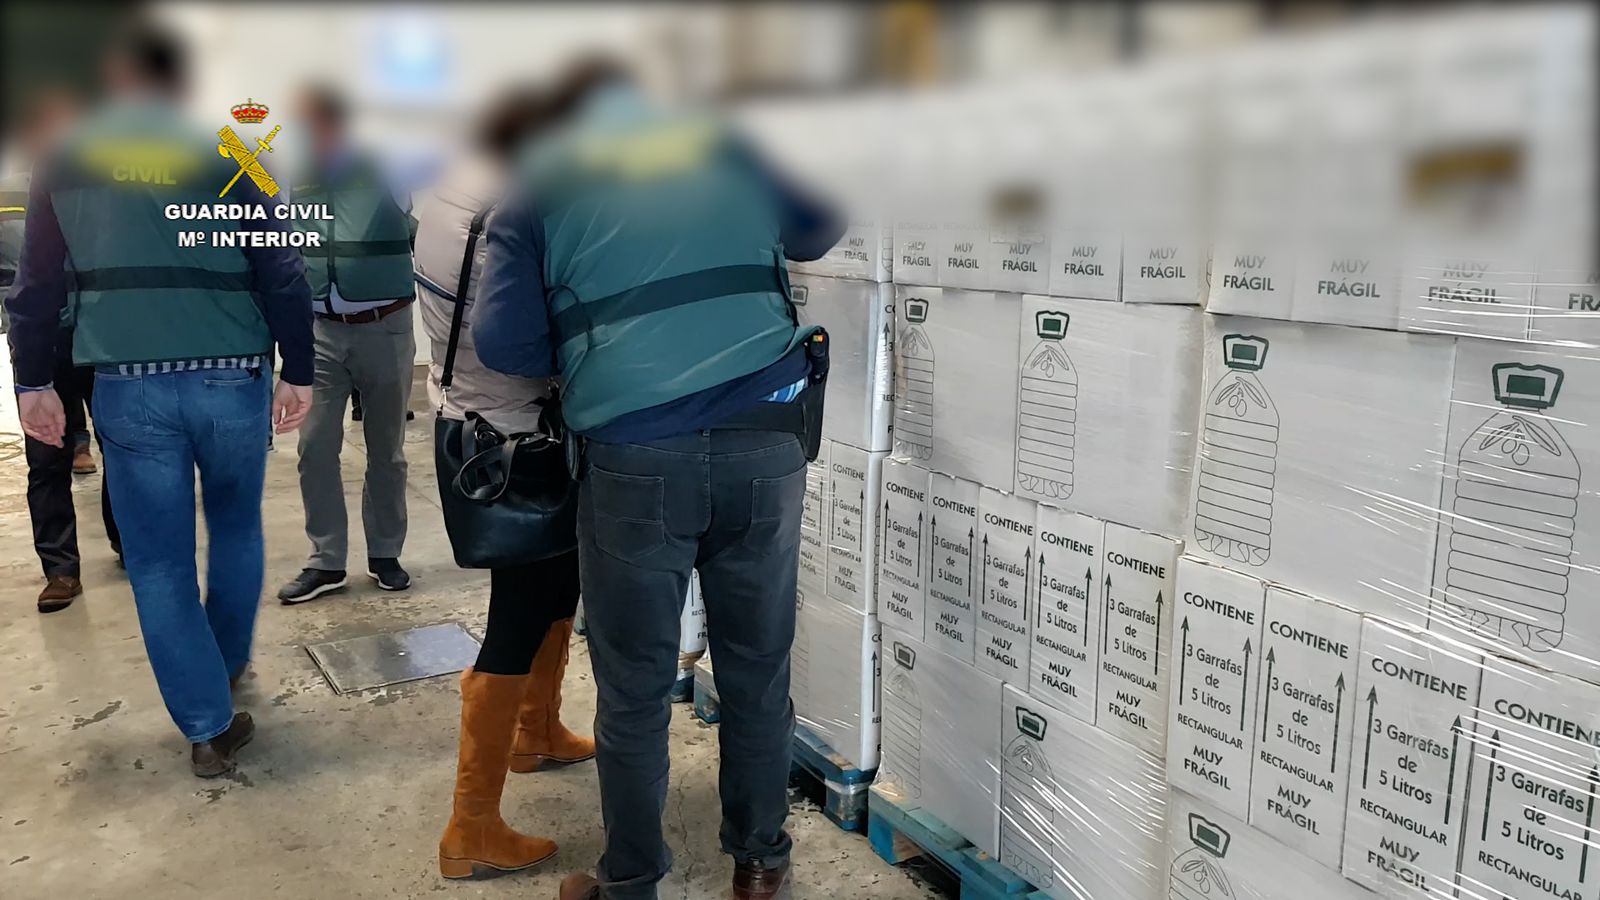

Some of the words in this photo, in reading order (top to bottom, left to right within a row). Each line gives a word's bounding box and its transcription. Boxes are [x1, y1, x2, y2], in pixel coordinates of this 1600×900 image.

[112, 166, 176, 186] CIVIL
[954, 243, 973, 252] MUY
[1010, 244, 1032, 255] MUY
[1072, 247, 1097, 259] MUY
[1149, 248, 1178, 260] MUY
[949, 256, 979, 269] FRÁGIL
[1003, 258, 1037, 272] FRÁGIL
[1064, 259, 1104, 276] FRÁGIL
[1141, 260, 1186, 278] FRÁGIL
[1234, 256, 1266, 269] MUY
[1330, 259, 1370, 274] MUY
[1224, 271, 1274, 291] FRÁGIL
[1318, 276, 1380, 298] FRÁGIL
[886, 481, 924, 502] CONTIENE
[933, 496, 975, 517] CONTIENE
[888, 518, 891, 529] 3
[893, 520, 918, 539] Garrafas
[984, 513, 1033, 536] CONTIENE
[897, 539, 906, 549] de
[935, 536, 938, 546] 3
[940, 537, 969, 557] Garrafas
[1041, 531, 1094, 556] CONTIENE
[890, 550, 894, 560] 5
[896, 552, 912, 567] Litros
[946, 556, 955, 566] de
[986, 554, 991, 565] 3
[992, 557, 1024, 577] Garrafas
[1107, 551, 1165, 579] CONTIENE
[883, 568, 919, 590] RECTANGULAR
[938, 570, 942, 579] 5
[944, 571, 962, 586] Litros
[999, 577, 1008, 588] de
[1043, 576, 1047, 586] 3
[1050, 579, 1085, 600] Garrafas
[892, 591, 908, 604] MUY
[930, 589, 970, 611] RECTANGULAR
[990, 589, 995, 600] 5
[996, 591, 1017, 609] Litros
[1057, 600, 1068, 612] de
[887, 600, 913, 620] FRÁGIL
[940, 612, 959, 625] MUY
[1110, 599, 1115, 610] 3
[1118, 601, 1156, 625] Garrafas
[1184, 592, 1254, 626] CONTIENE
[936, 622, 964, 643] FRÁGIL
[981, 610, 1026, 636] RECTANGULAR
[1047, 613, 1052, 624] 5
[1054, 614, 1077, 634] Litros
[1125, 624, 1137, 638] de
[992, 636, 1012, 650] MUY
[1036, 634, 1086, 662] RECTANGULAR
[1114, 640, 1120, 650] 5
[1122, 641, 1147, 661] Litros
[1270, 621, 1348, 660] CONTIENE
[986, 646, 1018, 669] FRÁGIL
[1187, 644, 1193, 657] 3
[1197, 647, 1242, 676] Garrafas
[1048, 662, 1071, 677] MUY
[1103, 662, 1157, 692] RECTANGULAR
[1372, 658, 1467, 700] CONTIENE
[1042, 673, 1078, 698] FRÁGIL
[1205, 673, 1219, 689] de
[1116, 690, 1140, 707] MUY
[1192, 688, 1198, 701] 5
[1202, 691, 1231, 714] Litros
[1272, 677, 1279, 691] 3
[1283, 680, 1334, 714] Garrafas
[1109, 704, 1148, 729] FRÁGIL
[1292, 709, 1309, 726] de
[1178, 713, 1243, 750] RECTANGULAR
[1277, 725, 1284, 738] 5
[1288, 727, 1321, 755] Litros
[1374, 719, 1382, 734] 3
[1387, 724, 1449, 759] Garrafas
[1193, 745, 1223, 765] MUY
[1398, 755, 1417, 773] de
[1185, 760, 1231, 791] FRÁGIL
[1260, 751, 1334, 792] RECTANGULAR
[1278, 785, 1311, 807] MUY
[1379, 771, 1387, 785] 5
[1393, 773, 1432, 804] Litros
[1496, 766, 1505, 782] 3
[1512, 772, 1584, 813] Garrafas
[1268, 799, 1320, 835] FRÁGIL
[1360, 798, 1447, 846] RECTANGULAR
[1524, 806, 1547, 826] de
[1380, 836, 1420, 862] MUY
[1502, 821, 1511, 837] 5
[1518, 827, 1564, 861] Litros
[1478, 851, 1583, 900] RECTANGULAR
